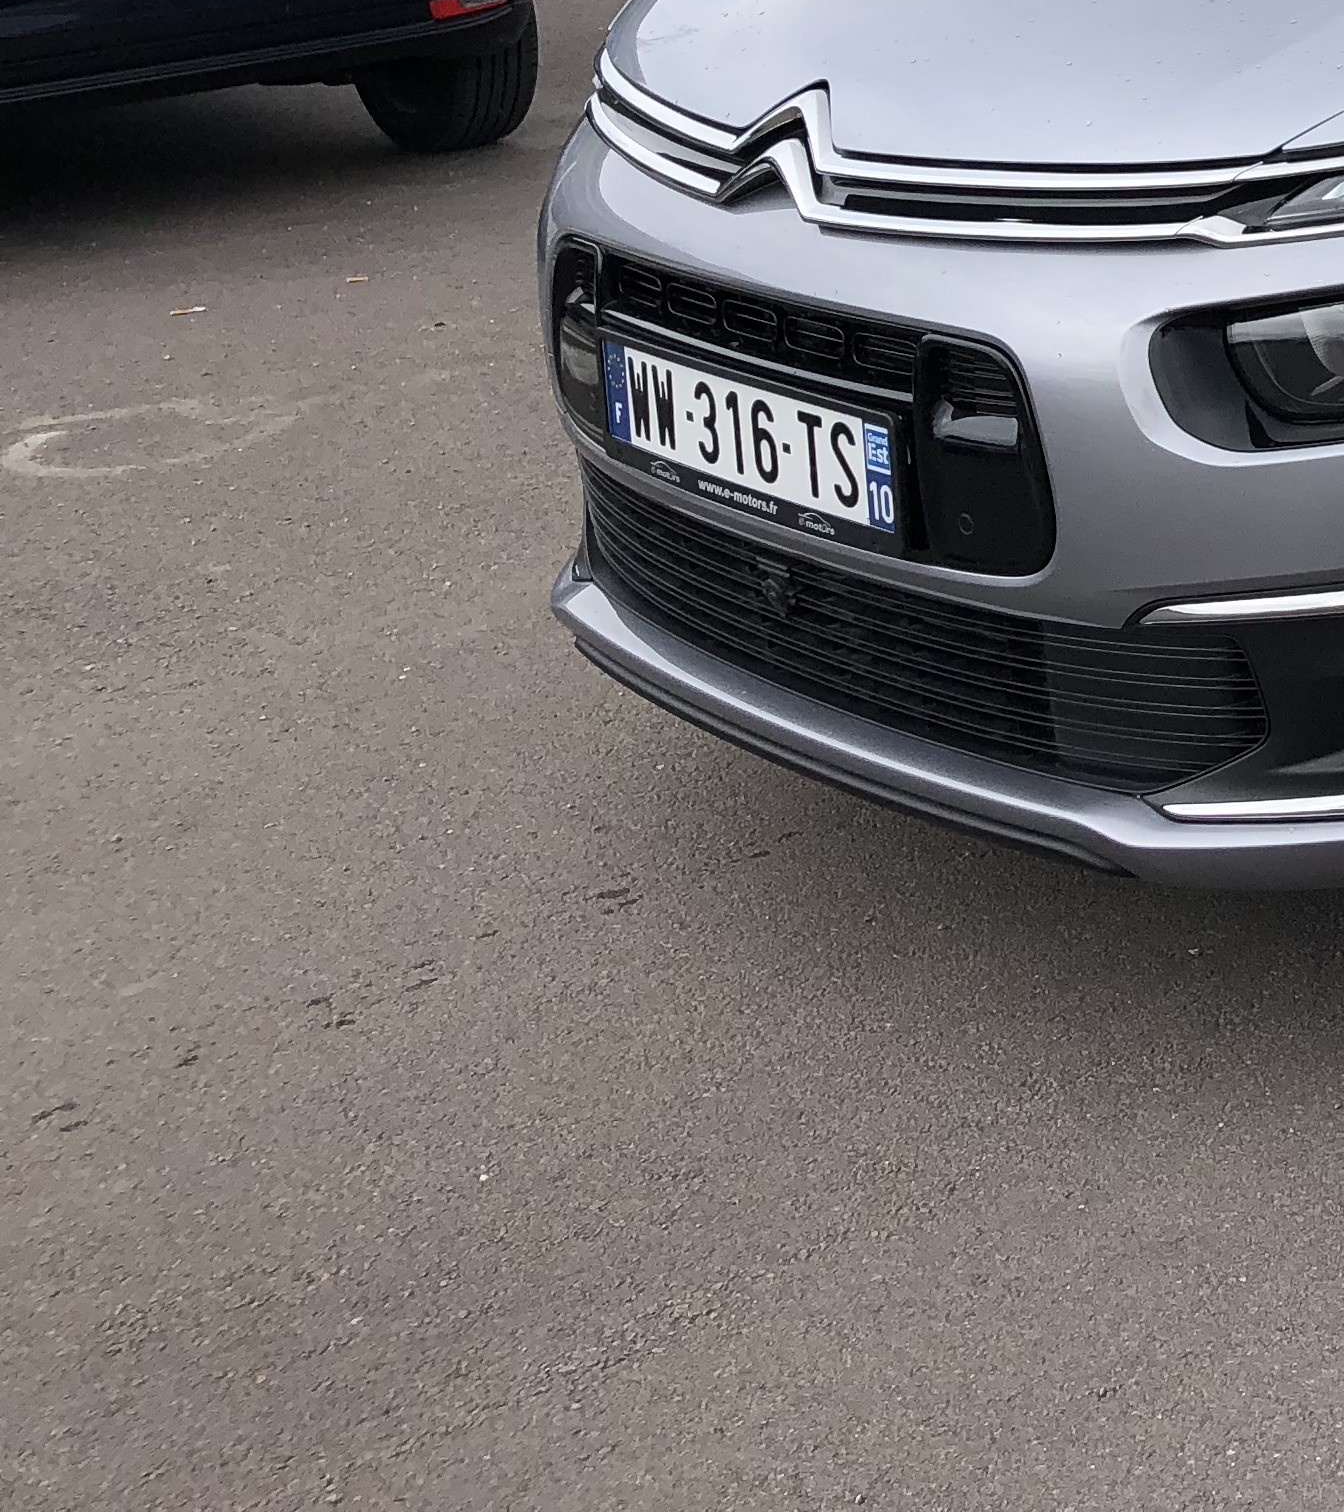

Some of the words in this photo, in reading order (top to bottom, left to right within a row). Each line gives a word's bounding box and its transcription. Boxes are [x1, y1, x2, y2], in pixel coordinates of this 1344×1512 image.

[614, 402, 623, 424] F
[868, 445, 890, 465] Est
[698, 478, 778, 516] www.e-motors.fr
[869, 481, 895, 524] 10
